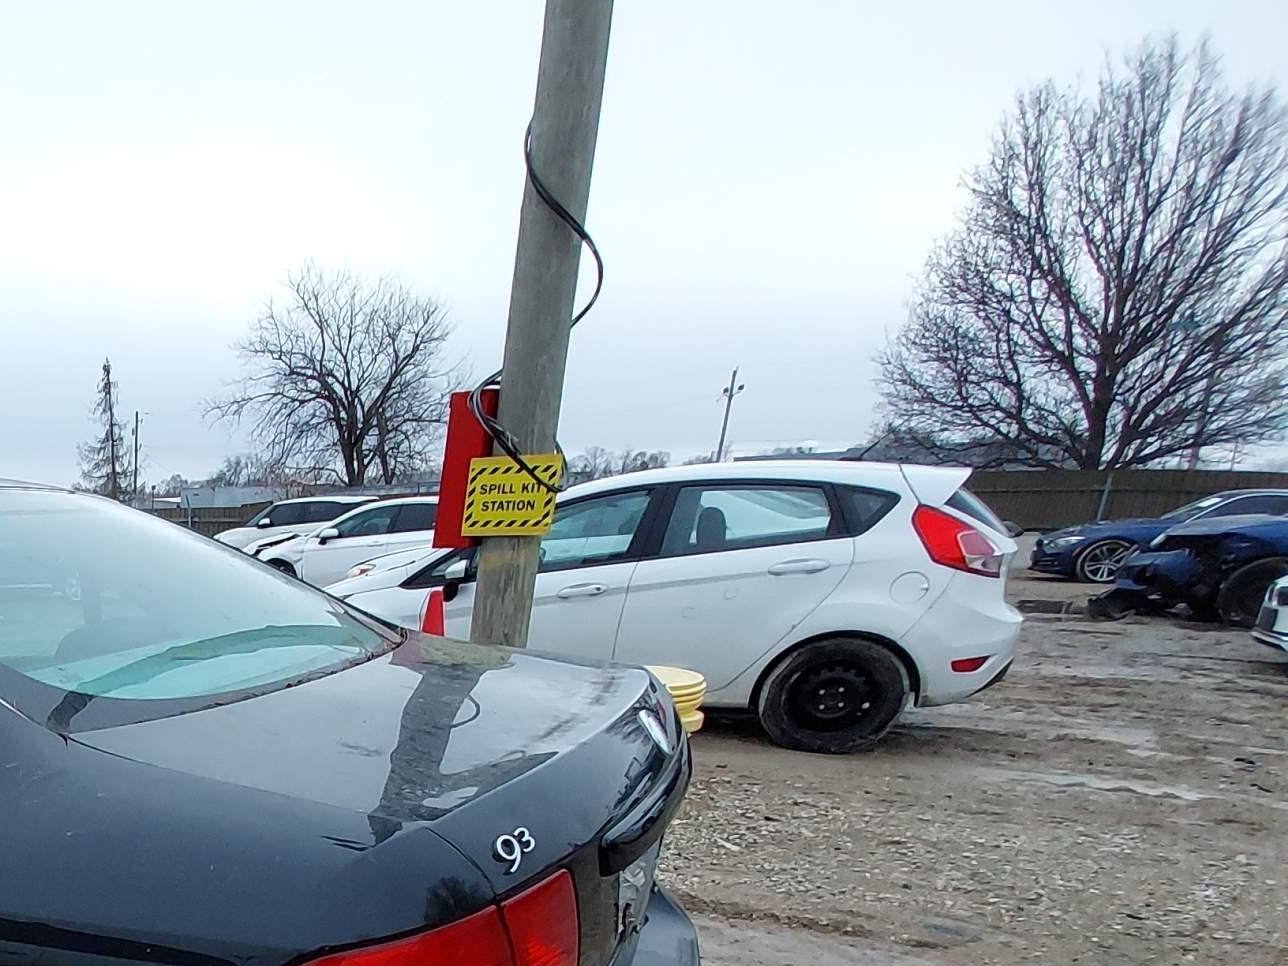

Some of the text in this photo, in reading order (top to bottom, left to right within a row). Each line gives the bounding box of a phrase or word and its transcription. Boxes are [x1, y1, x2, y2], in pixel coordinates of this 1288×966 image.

[479, 482, 541, 495] SPILL KIT
[481, 499, 536, 512] STATION
